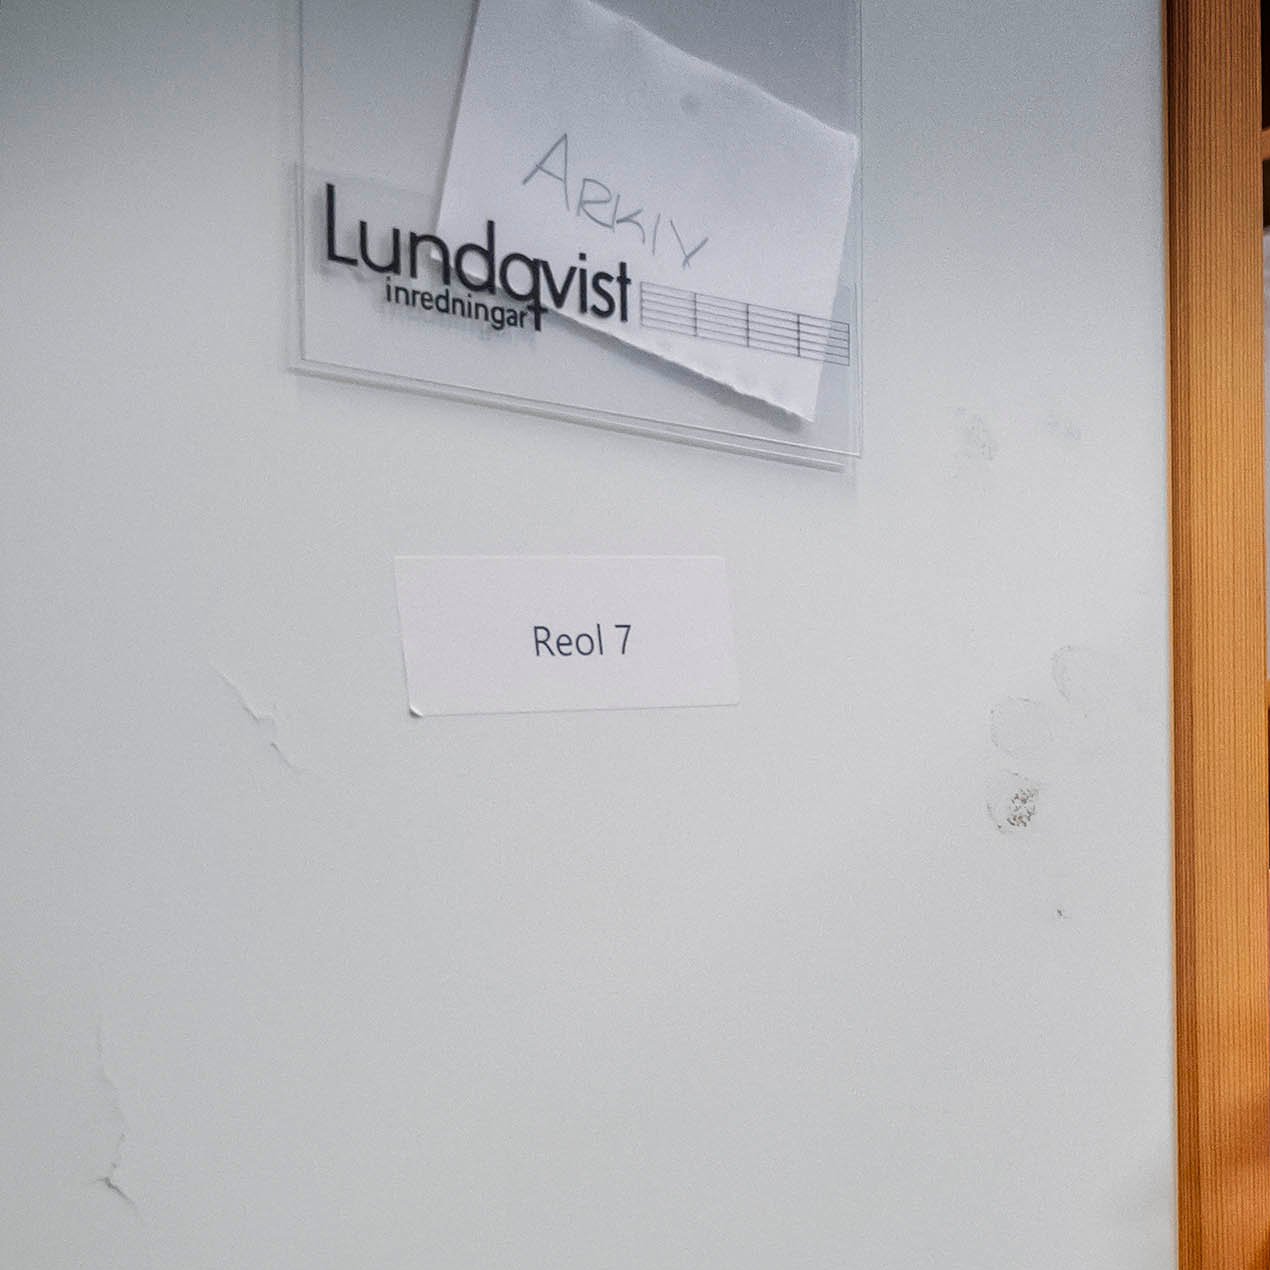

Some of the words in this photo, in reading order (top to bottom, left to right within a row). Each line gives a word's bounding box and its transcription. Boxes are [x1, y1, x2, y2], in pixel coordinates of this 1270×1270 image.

[326, 183, 632, 332] Lundqvist
[533, 623, 604, 657] Reol
[614, 624, 632, 655] 7
